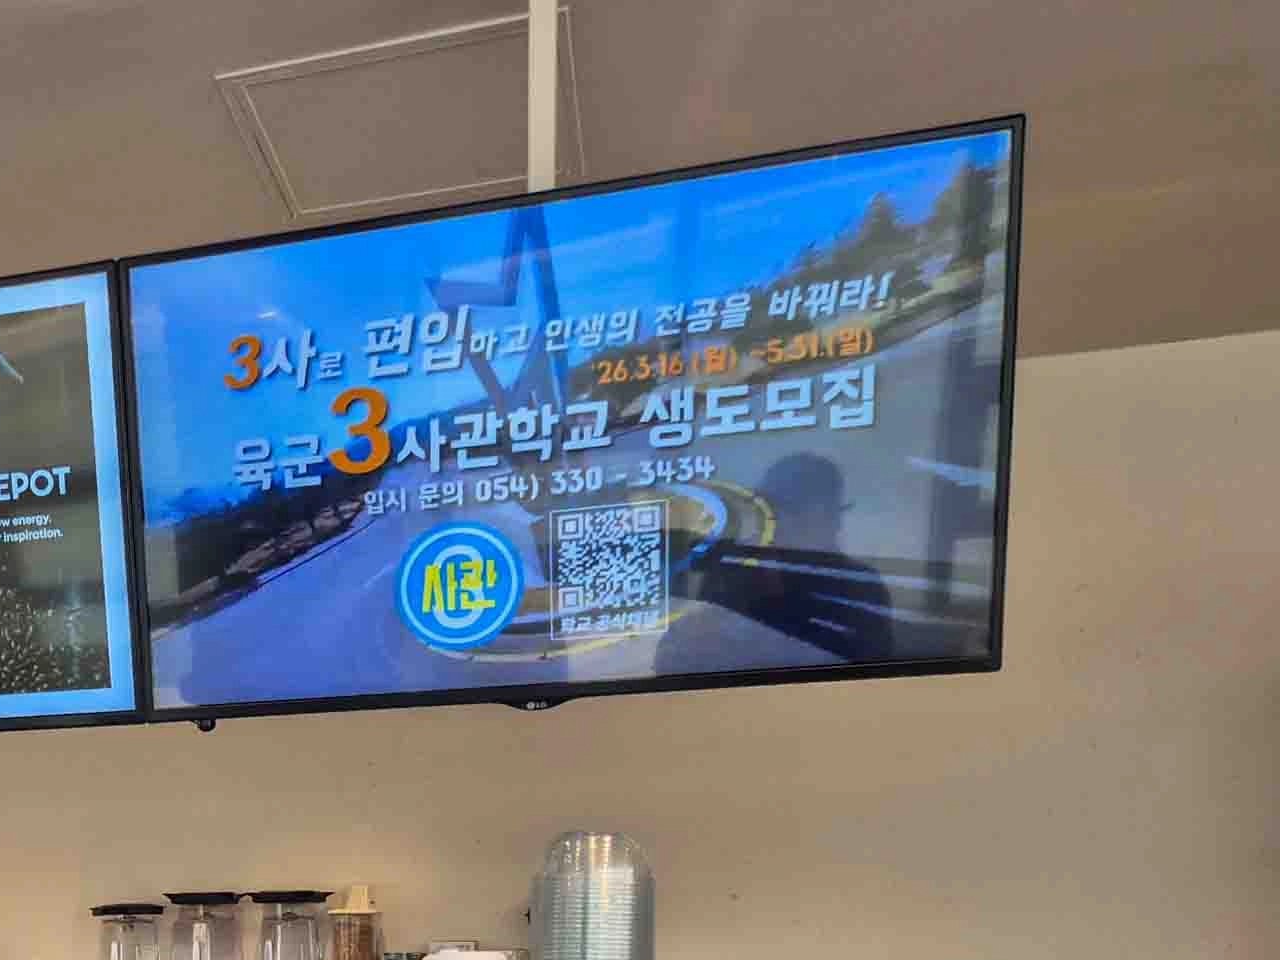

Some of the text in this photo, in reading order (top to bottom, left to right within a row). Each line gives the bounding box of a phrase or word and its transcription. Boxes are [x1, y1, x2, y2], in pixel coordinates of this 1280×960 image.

[364, 304, 534, 380] 편입하고
[544, 307, 638, 352] 인생의
[655, 292, 752, 337] 전공을
[768, 271, 895, 321] 바꿔라!
[640, 361, 877, 449] 생도모집
[363, 487, 407, 515] 입시
[419, 479, 464, 510] 문의
[474, 472, 540, 501] 054)
[550, 466, 604, 495] 330
[639, 455, 716, 486] 3434
[3, 527, 64, 544] inspiration.
[13, 512, 53, 526] energy.
